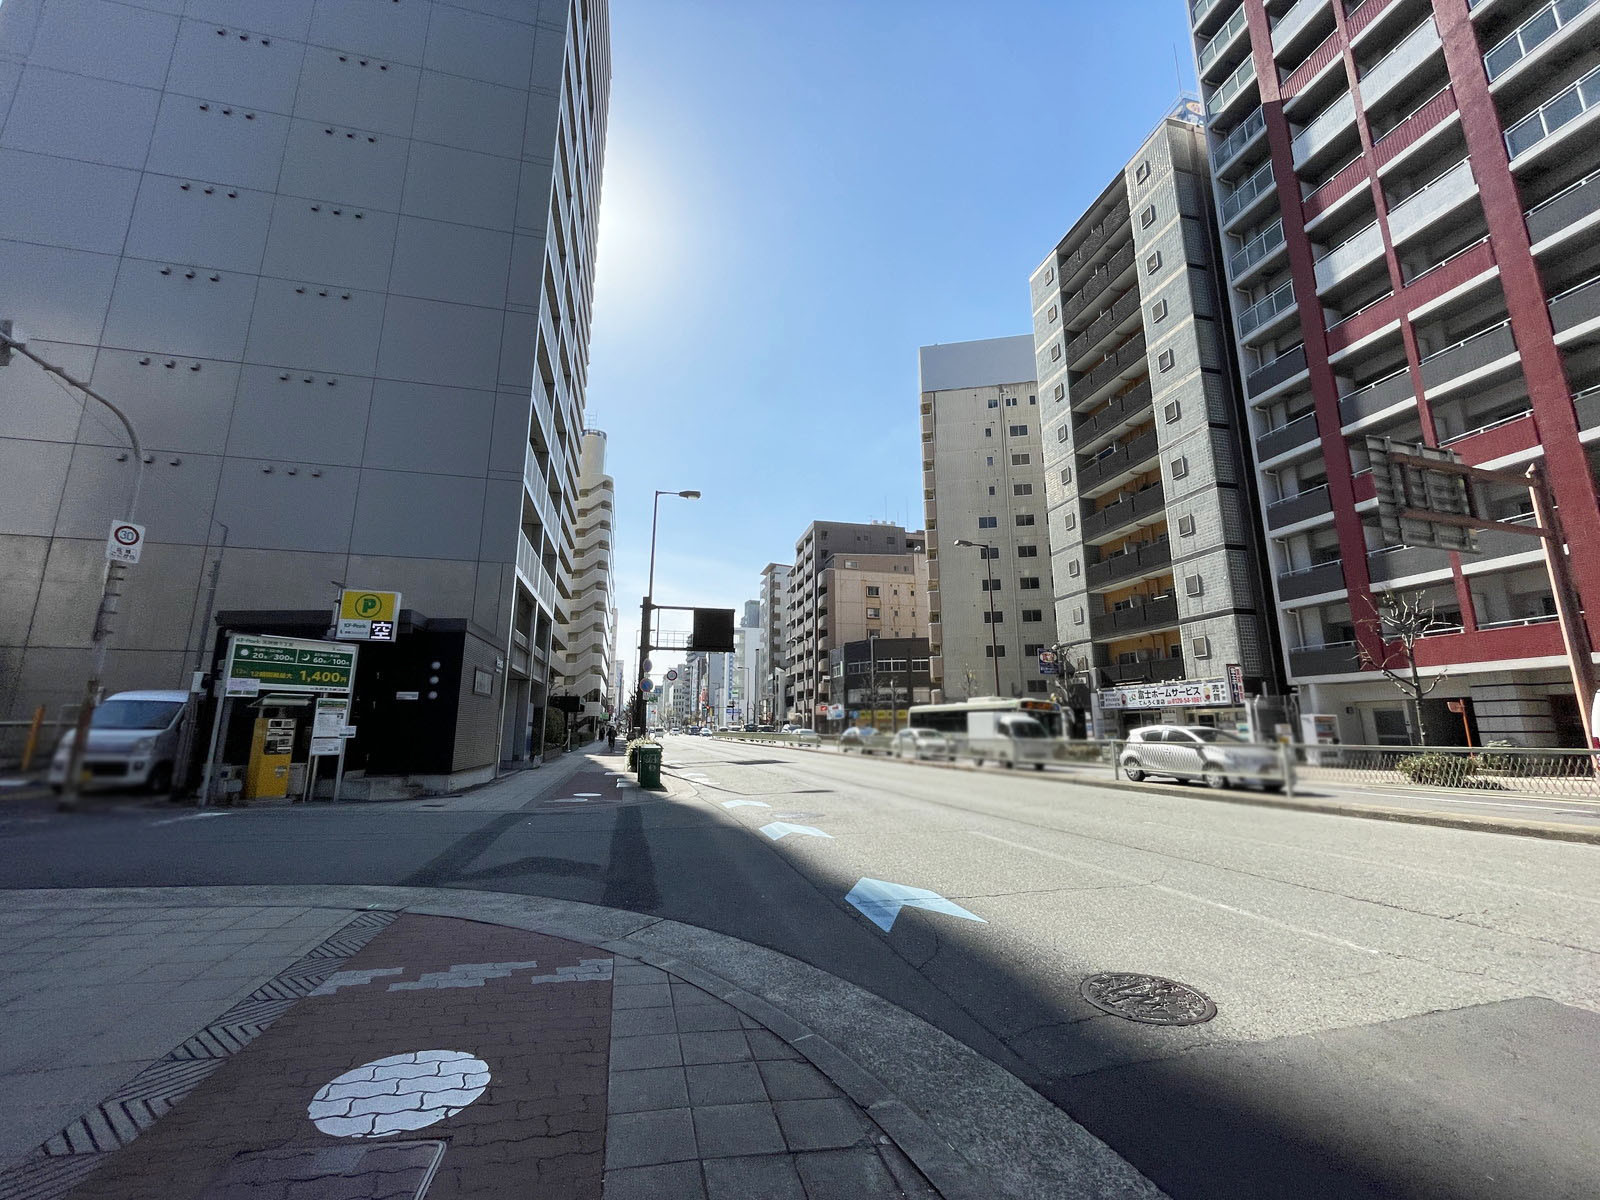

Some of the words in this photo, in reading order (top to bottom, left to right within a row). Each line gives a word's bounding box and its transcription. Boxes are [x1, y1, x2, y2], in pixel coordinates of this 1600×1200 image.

[120, 530, 134, 541] 30
[362, 598, 377, 613] P
[370, 621, 393, 640] 空
[300, 670, 347, 682] 1,400円
[1138, 687, 1200, 699] 富士ホームサービス
